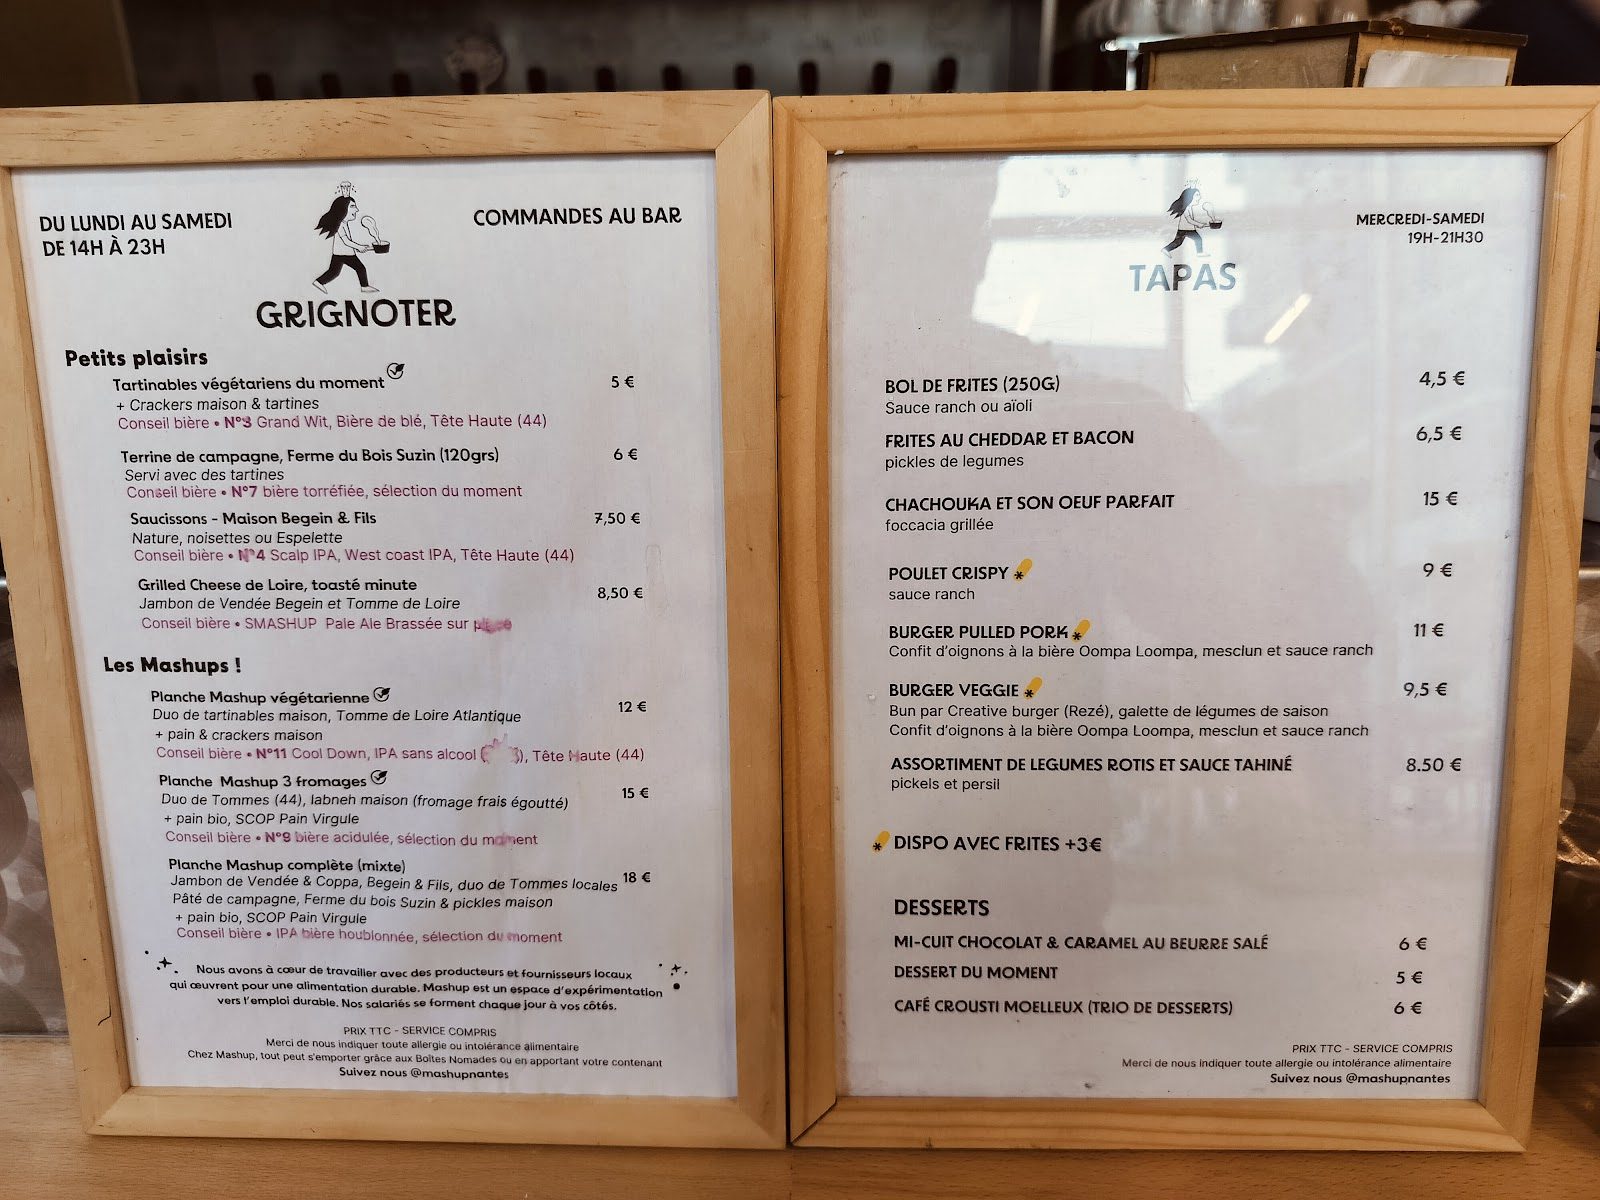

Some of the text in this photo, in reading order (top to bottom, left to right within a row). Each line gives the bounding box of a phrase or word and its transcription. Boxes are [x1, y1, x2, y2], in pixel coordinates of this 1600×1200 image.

[39, 212, 232, 232] DU LUNDI AU SAMEDI
[473, 207, 682, 226] COMMANDES AU BAR
[1356, 212, 1484, 226] MERCREDI-SAMEDI
[42, 234, 165, 256] DE 14H À 23H
[1408, 231, 1483, 244] 19H-21H30
[1129, 262, 1236, 291] TAPAS
[256, 298, 456, 329] GRIGNOTER
[65, 347, 208, 370] Petits plaisirs
[112, 376, 385, 393] Tartinables végétariens du moment
[611, 376, 634, 388] 5 €
[886, 375, 1060, 394] BOL DE FRITES (250G)
[1419, 371, 1465, 389] 4,5 €
[116, 397, 319, 411] + Crackers maison & tartines
[886, 430, 1134, 448] FRITES AU CHEDDAR ET BACON
[1416, 426, 1462, 443] 6,5 €
[120, 447, 499, 465] Terrine de campagne, Ferme du Bois Suzin (120grs)
[613, 448, 638, 460] 6 €
[125, 468, 284, 481] Servi avec des tartines
[885, 494, 1175, 512] CHACHOUKA ET SON OEUF PARFAIT
[1423, 491, 1458, 506] 15 €
[594, 512, 640, 526] 7,50 €
[885, 517, 994, 534] foccacia grillée
[889, 566, 1009, 581] POULET CRISPY
[1423, 563, 1453, 577] 9 €
[138, 578, 417, 593] Grilled Cheese de Loire, toasté minute
[597, 587, 643, 601] 8,50 €
[889, 625, 1068, 639] BURGER PULLED PORK
[1414, 623, 1444, 637] 11 €
[103, 656, 241, 676] Les Mashups !
[151, 689, 370, 706] Planche Mashup végétarienne
[889, 683, 1019, 697] BURGER VEGGIE
[1404, 682, 1448, 699] 9,5 €
[618, 701, 646, 712] 12 €
[890, 755, 1292, 772] ASSORTIMENT DE LEGUMES ROTIS ET SAUCE TAHINÉ
[1406, 758, 1462, 772] 8.50 €
[159, 774, 367, 790] Planche Mashup 3 fromages
[622, 787, 649, 799] 15 €
[894, 835, 1102, 852] DISPO AVEC FRITES +3€
[169, 858, 405, 874] Planche Mashup complète (mixte)
[623, 872, 651, 883] 18 €
[895, 899, 989, 917] DESSERTS
[196, 964, 225, 974] Nous
[228, 967, 263, 975] avons
[265, 965, 274, 974] à
[309, 965, 323, 975] de
[326, 966, 377, 977] travailler
[410, 969, 432, 978] des
[435, 967, 504, 978] producteurs
[507, 969, 519, 978] et
[521, 969, 591, 980] fournisseurs
[594, 969, 632, 980] locaux
[894, 965, 1058, 979] DESSERT DU MOMENT
[1396, 971, 1423, 984] 5 €
[1122, 1059, 1151, 1067] Merci
[1154, 1059, 1168, 1068] de
[1199, 1059, 1242, 1069] indiquer
[1245, 1059, 1272, 1068] toute
[1275, 1058, 1313, 1070] allergie
[1316, 1060, 1329, 1068] ou
[1332, 1058, 1391, 1068] intolérance
[1393, 1058, 1452, 1068] alimentaire
[339, 1067, 377, 1077] Suivez
[410, 1068, 509, 1080] @mashupnantes
